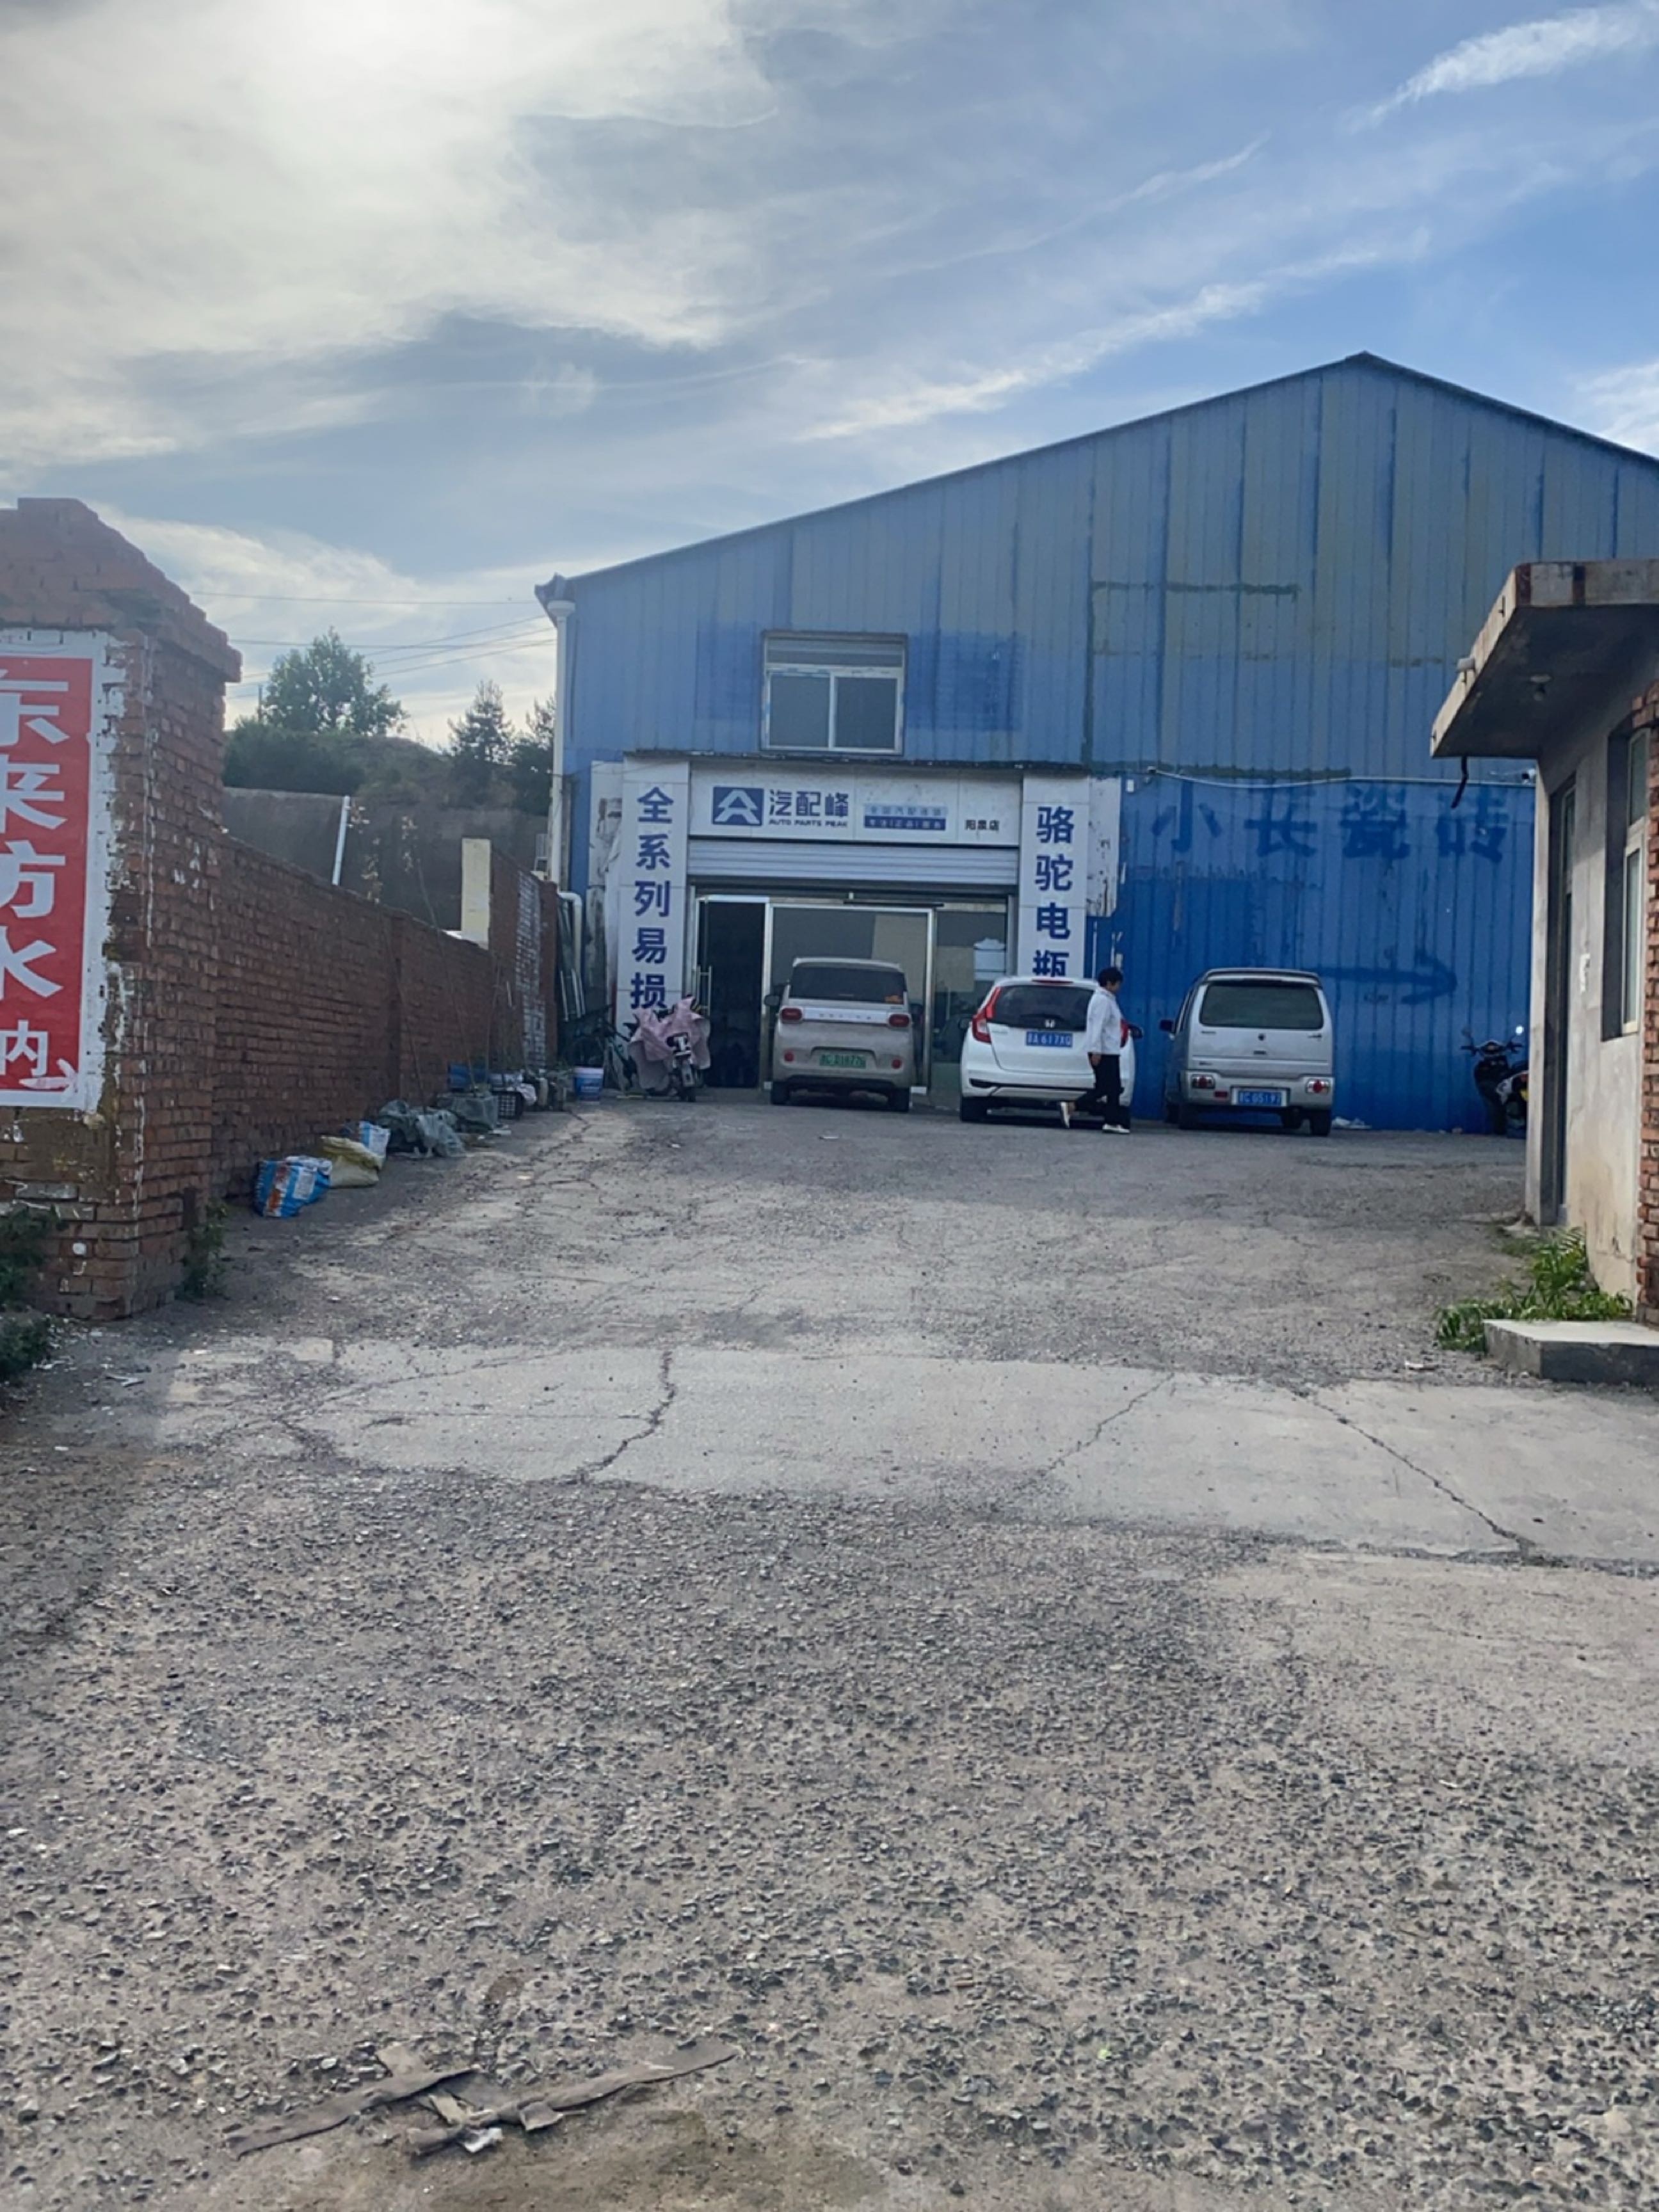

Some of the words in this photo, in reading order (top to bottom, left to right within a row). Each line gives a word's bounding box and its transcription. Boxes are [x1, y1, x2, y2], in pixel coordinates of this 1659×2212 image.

[769, 789, 849, 817] 汽配峰
[1032, 806, 1074, 977] 骆驼电瓶
